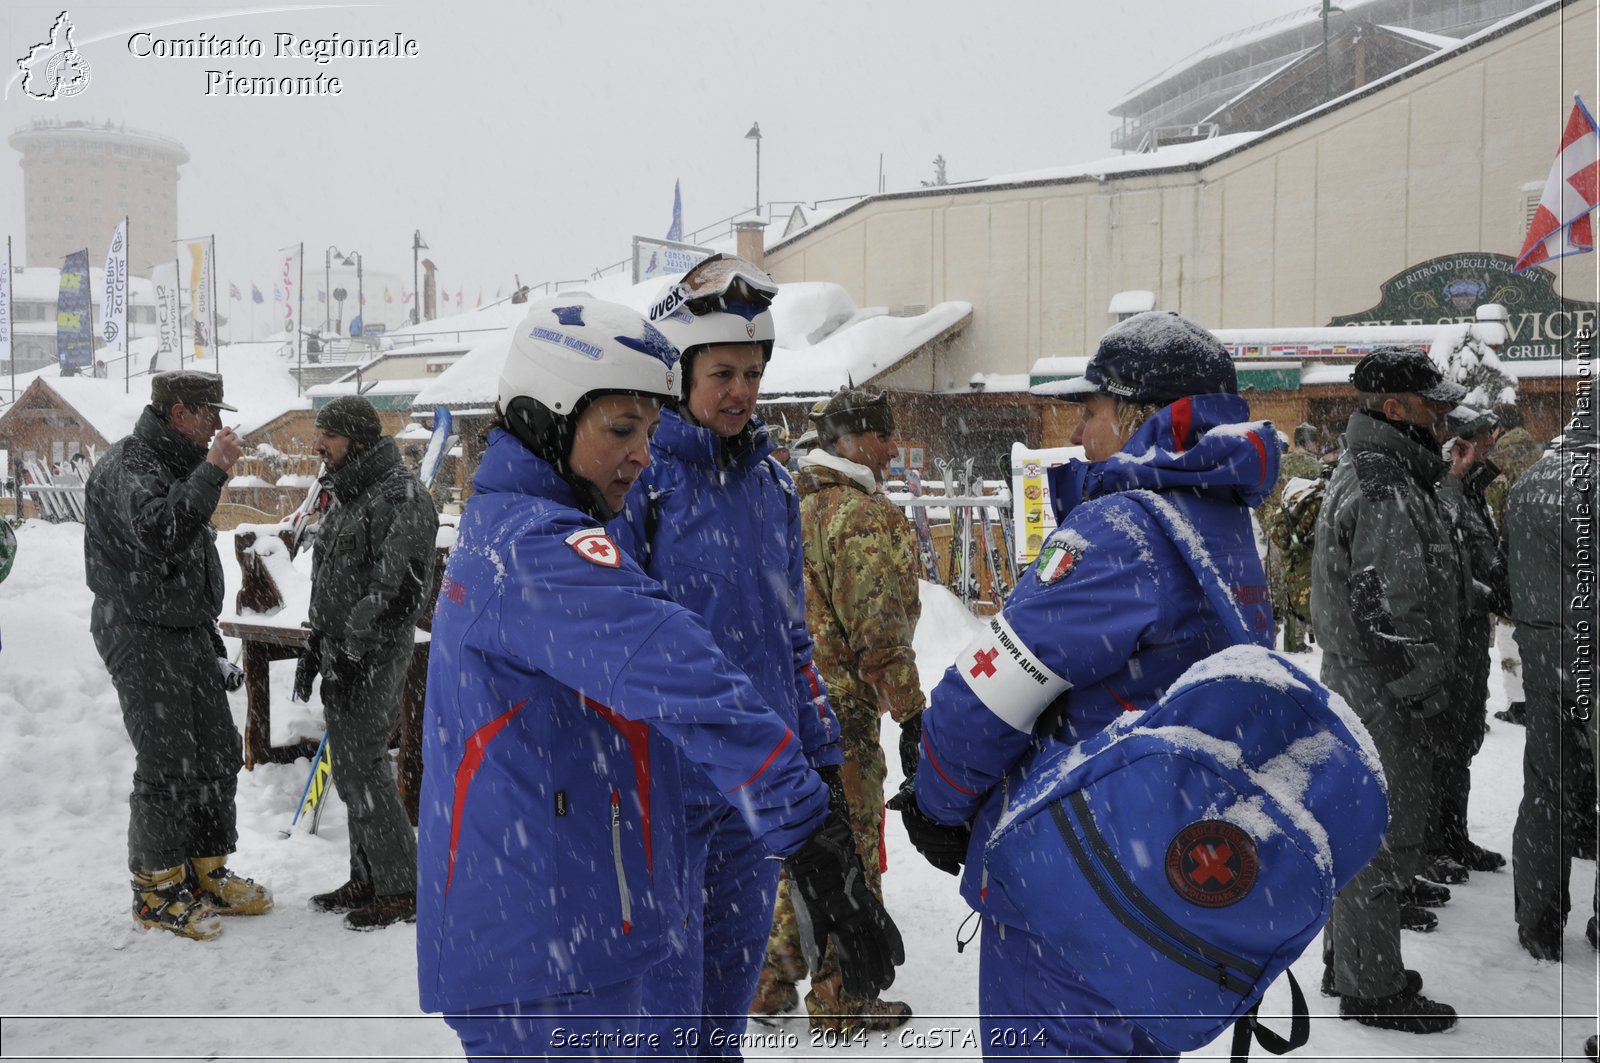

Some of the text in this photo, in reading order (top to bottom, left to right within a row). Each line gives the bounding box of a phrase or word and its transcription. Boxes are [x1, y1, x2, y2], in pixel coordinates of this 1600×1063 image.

[1395, 258, 1540, 290] IL RITROVO DEGLI SCIAORI
[650, 287, 683, 321] uvex
[564, 336, 602, 358] VOLONTARIE
[1507, 344, 1562, 358] GRILL
[998, 631, 1022, 660] TRUPPE
[1019, 658, 1048, 685] ALPINE
